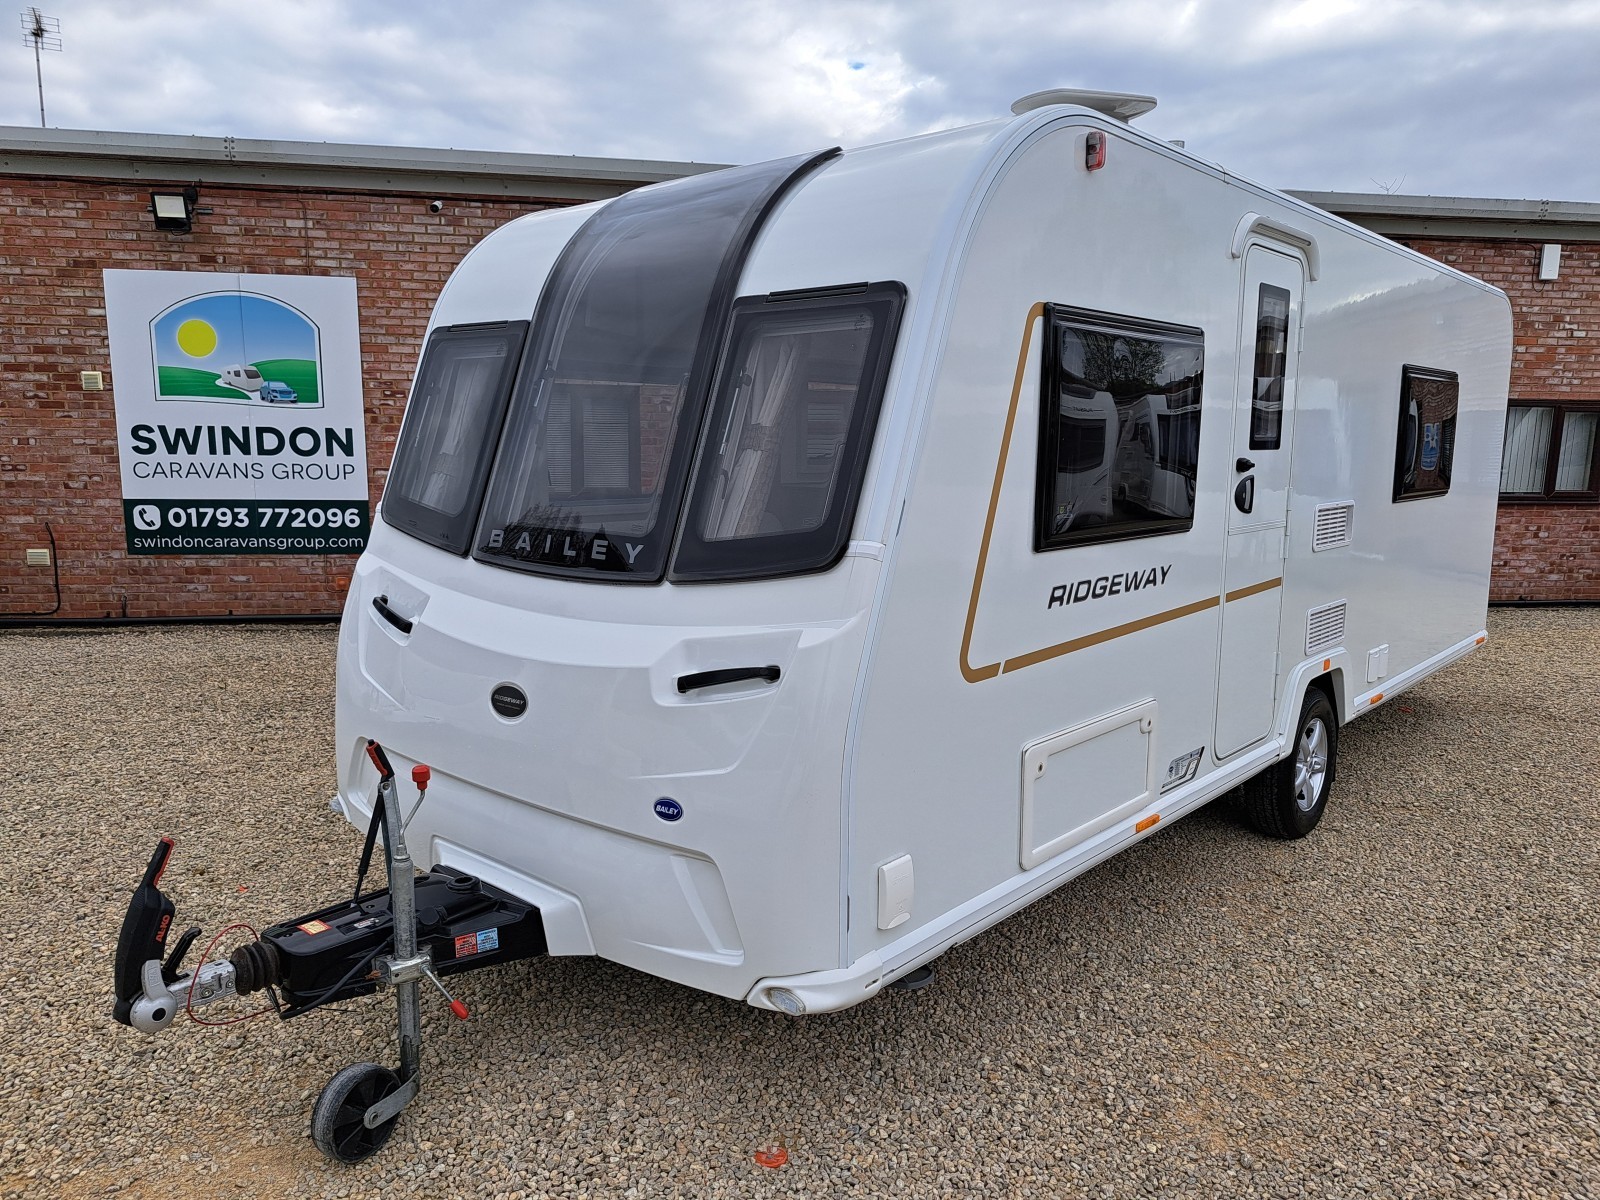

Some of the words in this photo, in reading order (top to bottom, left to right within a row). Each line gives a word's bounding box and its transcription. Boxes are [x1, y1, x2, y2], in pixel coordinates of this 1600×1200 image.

[130, 424, 354, 457] SWINDON
[133, 461, 264, 479] CARAVANS
[272, 462, 355, 480] GROUP
[168, 507, 249, 528] 01793
[257, 507, 360, 528] 772096
[134, 535, 364, 550] swindoncaravansgroup.com
[488, 529, 644, 565] BAILEY
[1047, 564, 1172, 609] RIDGEWAY
[493, 694, 525, 705] RIDGEWAY
[655, 804, 679, 816] BAILEY
